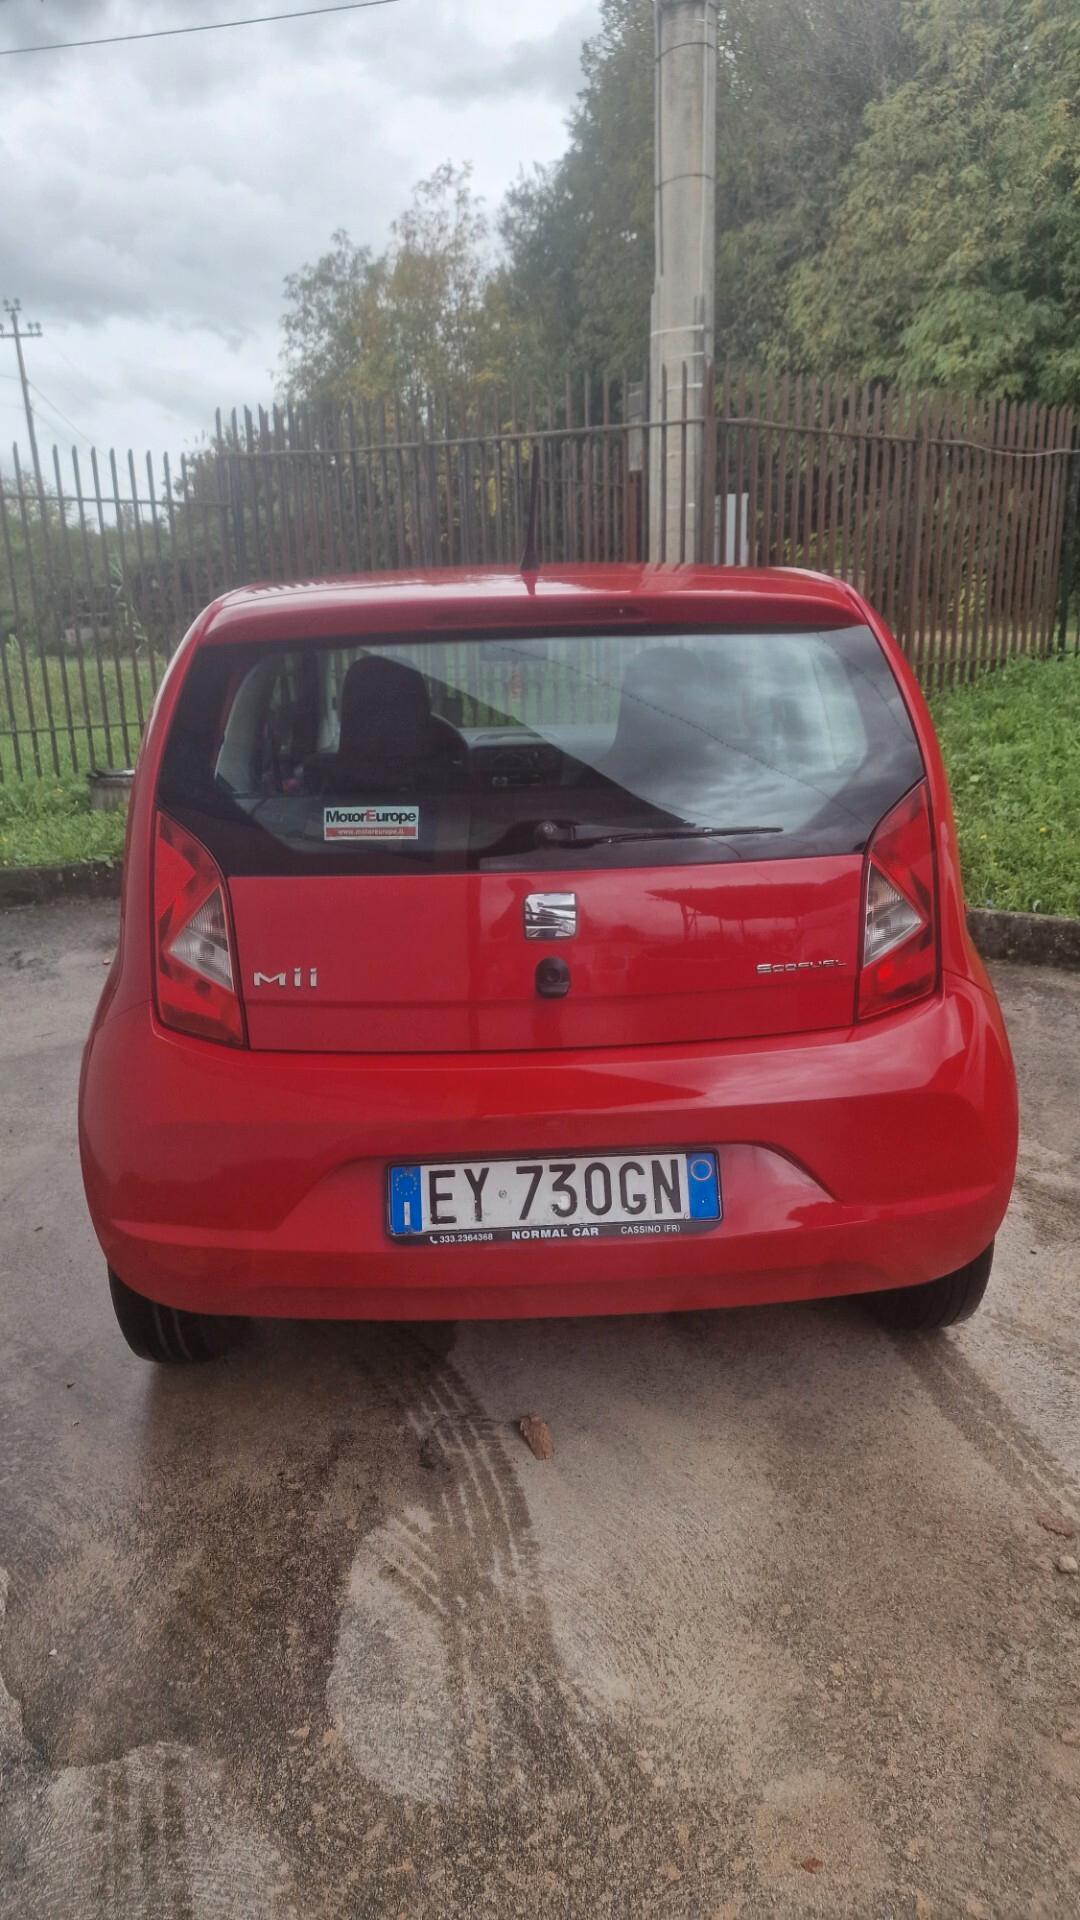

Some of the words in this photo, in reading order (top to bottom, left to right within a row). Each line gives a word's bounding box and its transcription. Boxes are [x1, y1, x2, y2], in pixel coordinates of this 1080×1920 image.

[326, 809, 417, 824] MotorEurope
[253, 967, 318, 987] Mii
[429, 1167, 490, 1225] EY
[516, 1159, 682, 1220] 730GN
[511, 1228, 568, 1240] NORMAL
[572, 1227, 600, 1237] CAR
[621, 1225, 662, 1235] CASSINO
[664, 1224, 681, 1234] (FR)
